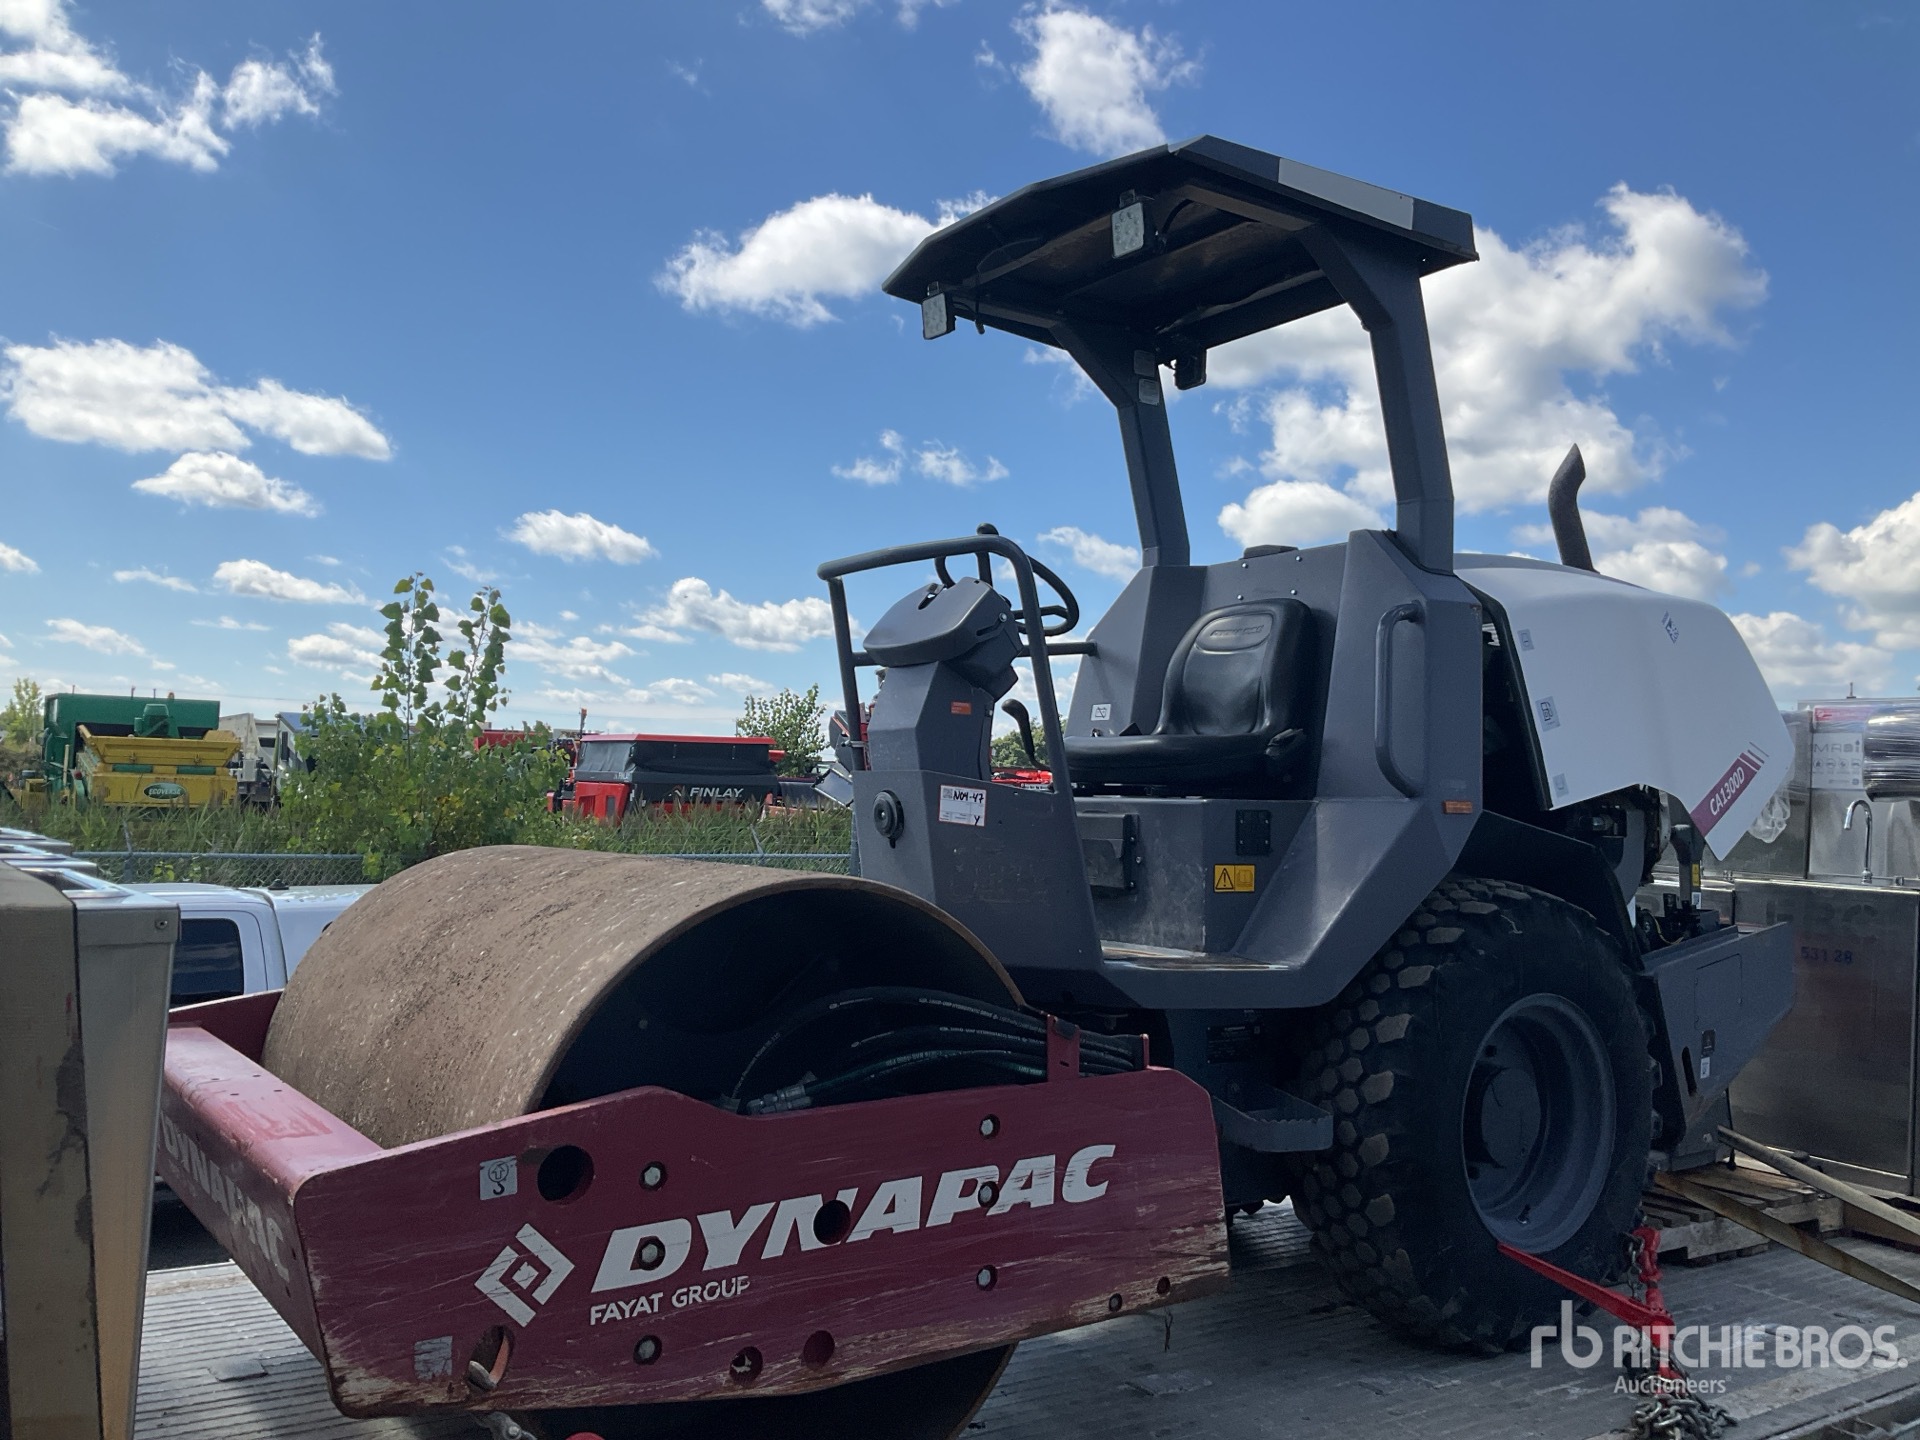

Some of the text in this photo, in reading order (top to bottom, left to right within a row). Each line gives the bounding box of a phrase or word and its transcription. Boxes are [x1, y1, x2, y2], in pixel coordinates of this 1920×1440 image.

[689, 786, 744, 798] FINLAY
[1709, 766, 1745, 816] CA1300D
[590, 1144, 1116, 1294] DYNAPAC
[589, 1274, 751, 1326] FAYAT GROUP
